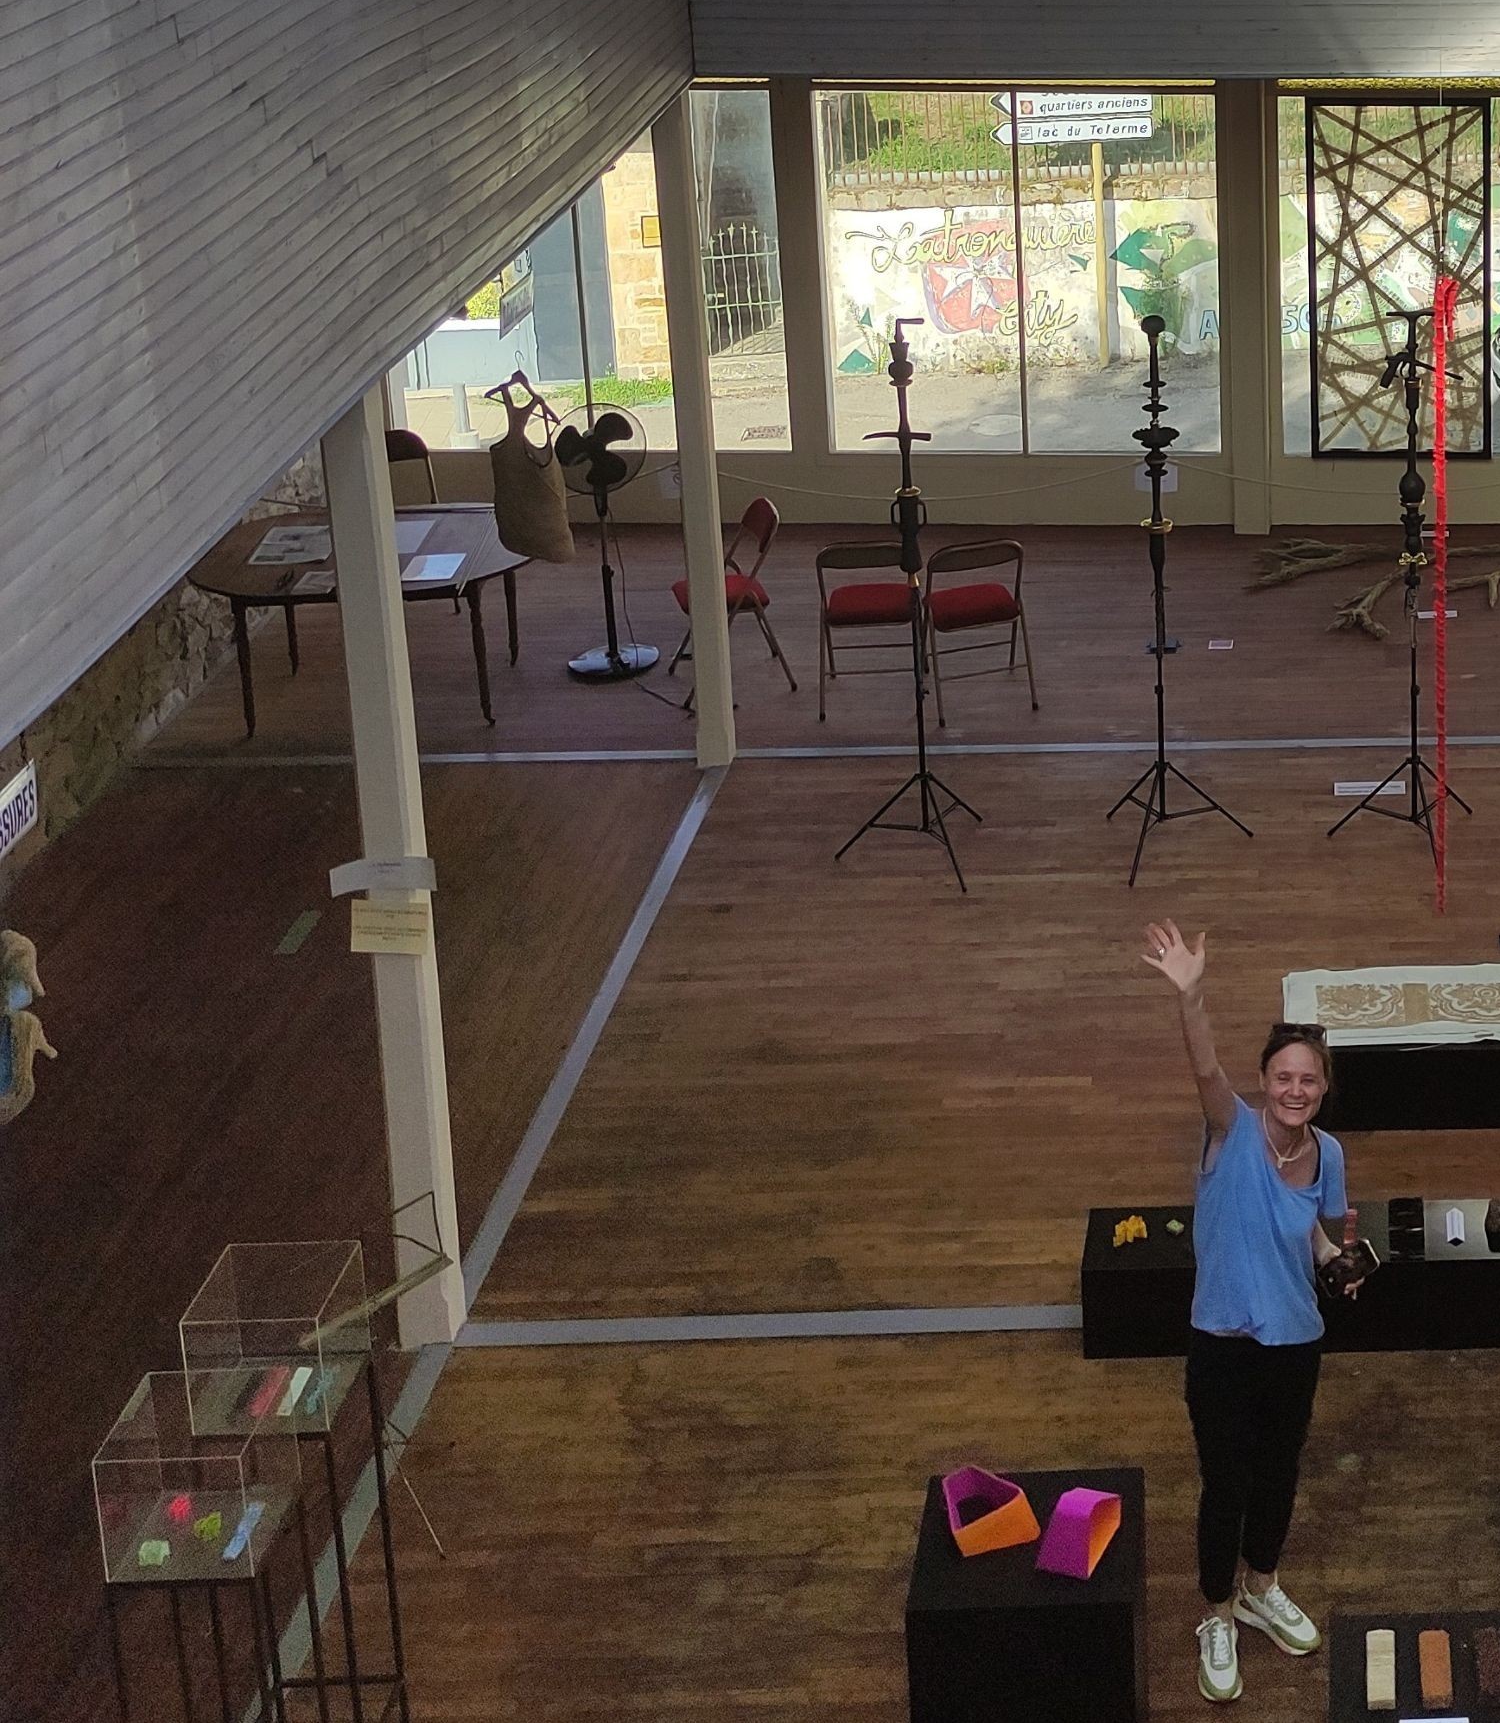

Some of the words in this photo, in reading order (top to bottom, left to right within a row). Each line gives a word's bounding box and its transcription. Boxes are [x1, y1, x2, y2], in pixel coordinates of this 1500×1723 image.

[1039, 99, 1093, 114] quartiers
[1098, 96, 1148, 109] anciens
[1037, 126, 1059, 137] lac
[1067, 125, 1081, 137] du
[996, 290, 1078, 347] City
